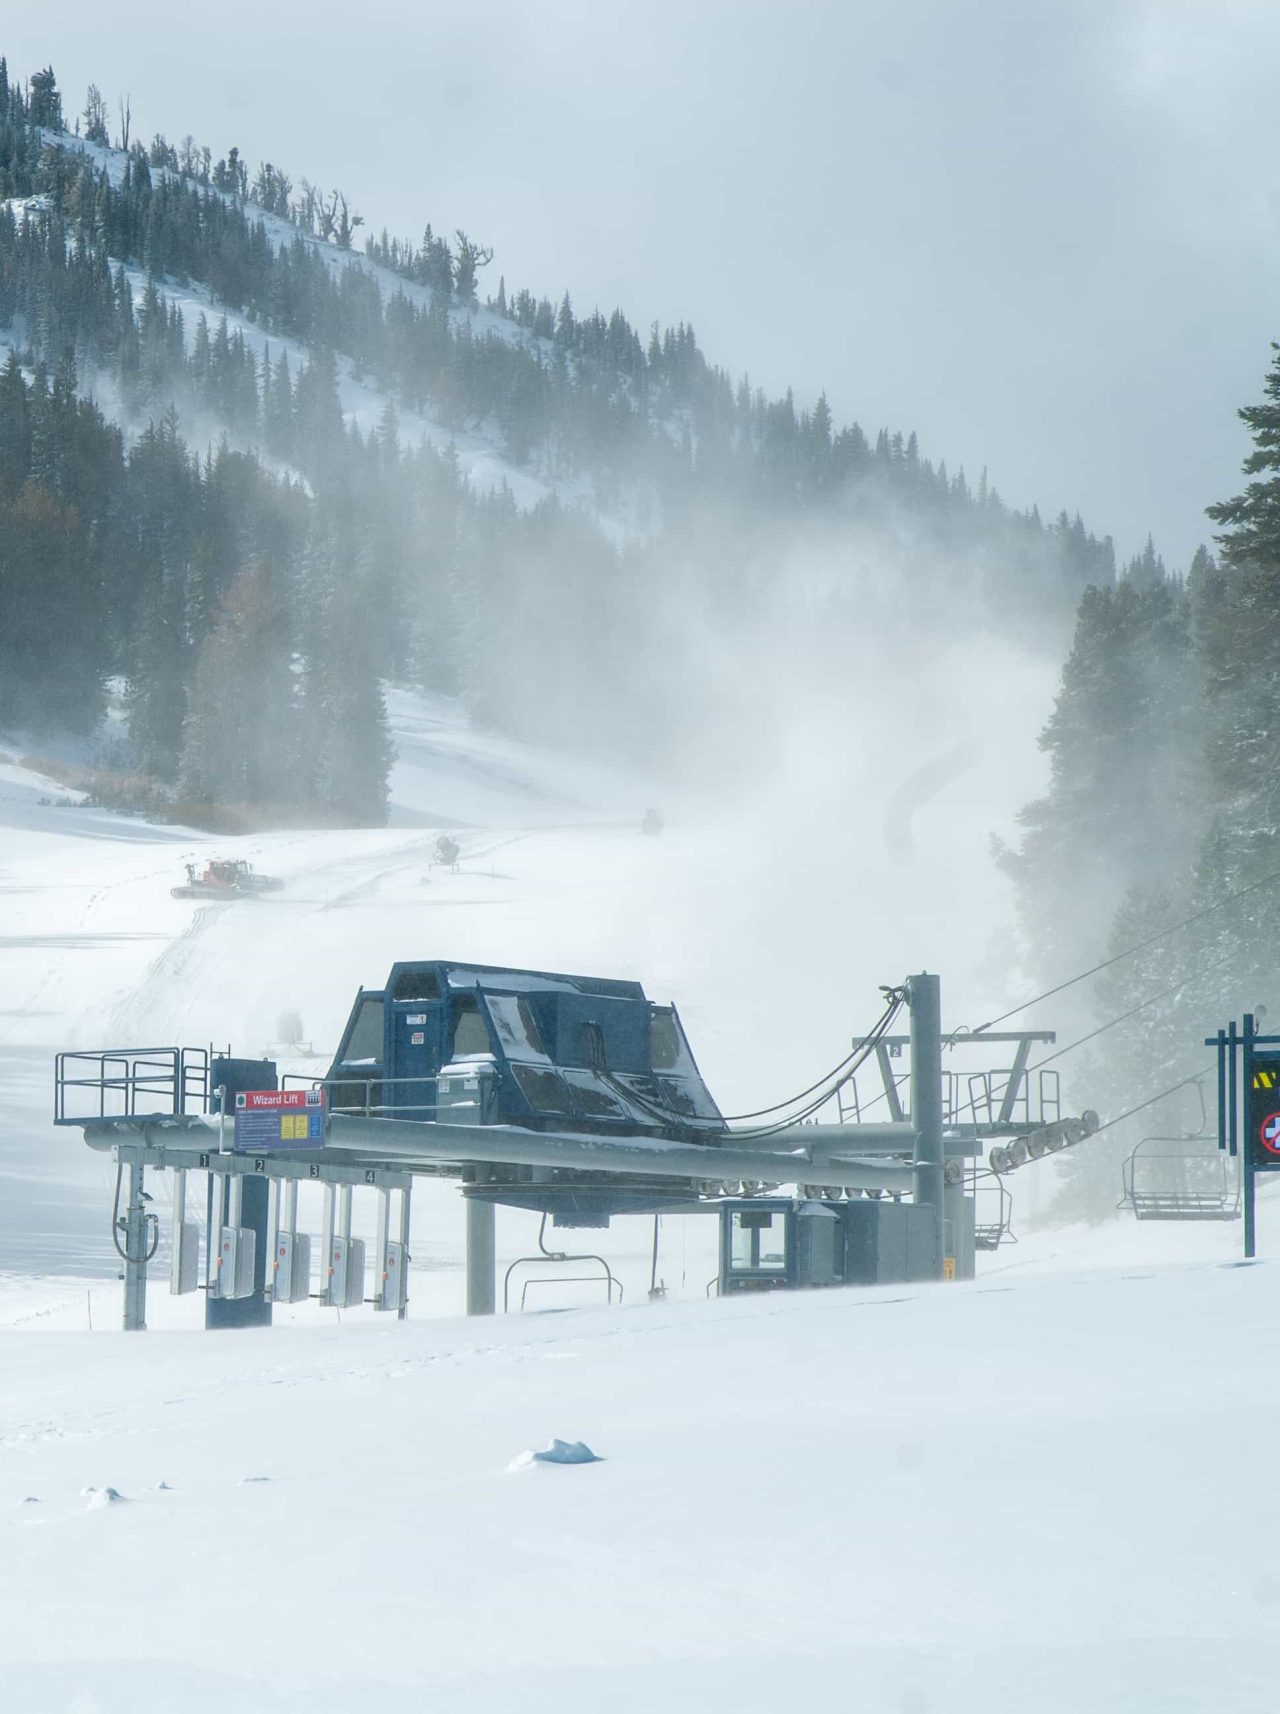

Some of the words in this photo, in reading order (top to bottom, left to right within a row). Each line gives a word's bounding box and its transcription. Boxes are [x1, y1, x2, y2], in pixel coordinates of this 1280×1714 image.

[893, 1047, 899, 1057] 2
[253, 1095, 282, 1105] Wizard
[284, 1094, 298, 1104] Lift
[202, 1155, 207, 1167] 1
[257, 1160, 264, 1172] 2
[311, 1165, 318, 1177] 3
[366, 1171, 374, 1183] 4
